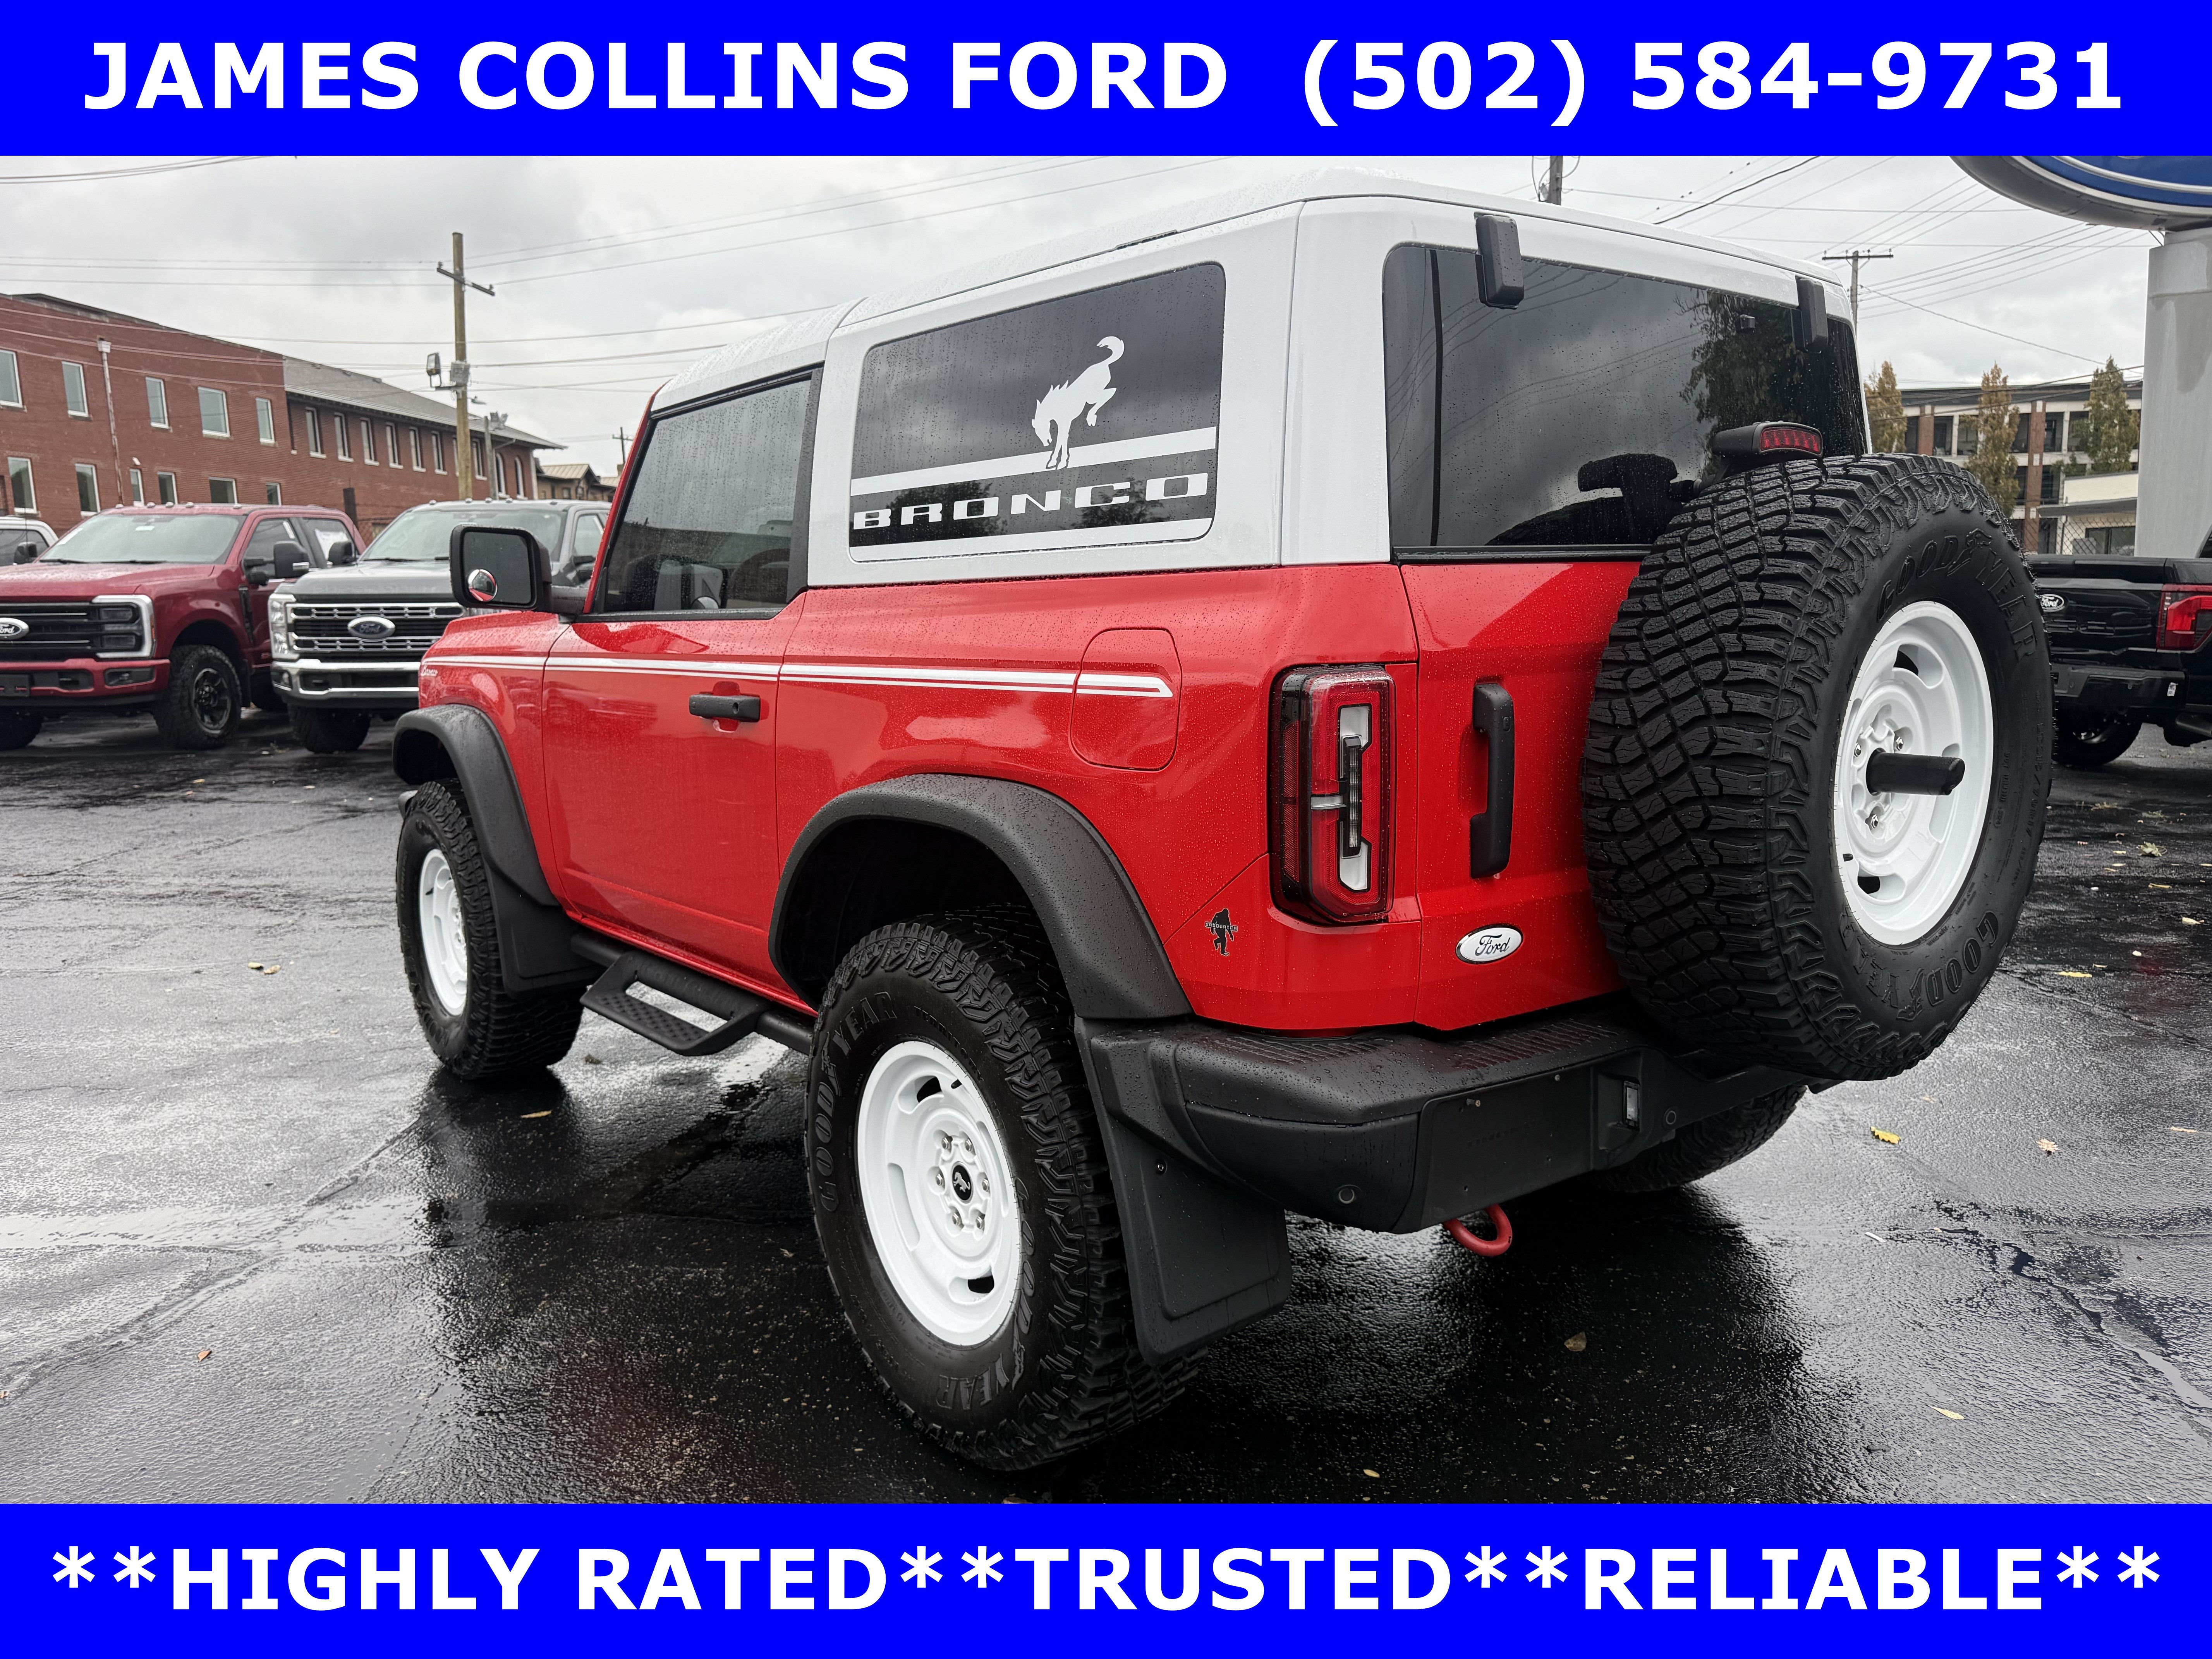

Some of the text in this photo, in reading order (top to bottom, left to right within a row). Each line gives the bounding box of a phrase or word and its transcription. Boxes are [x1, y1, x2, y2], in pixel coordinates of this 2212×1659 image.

[853, 472, 1208, 530] BRONCO
[359, 623, 381, 633] Ford
[1205, 922, 1237, 931] SASQUATCH
[1475, 934, 1511, 956] Ford
